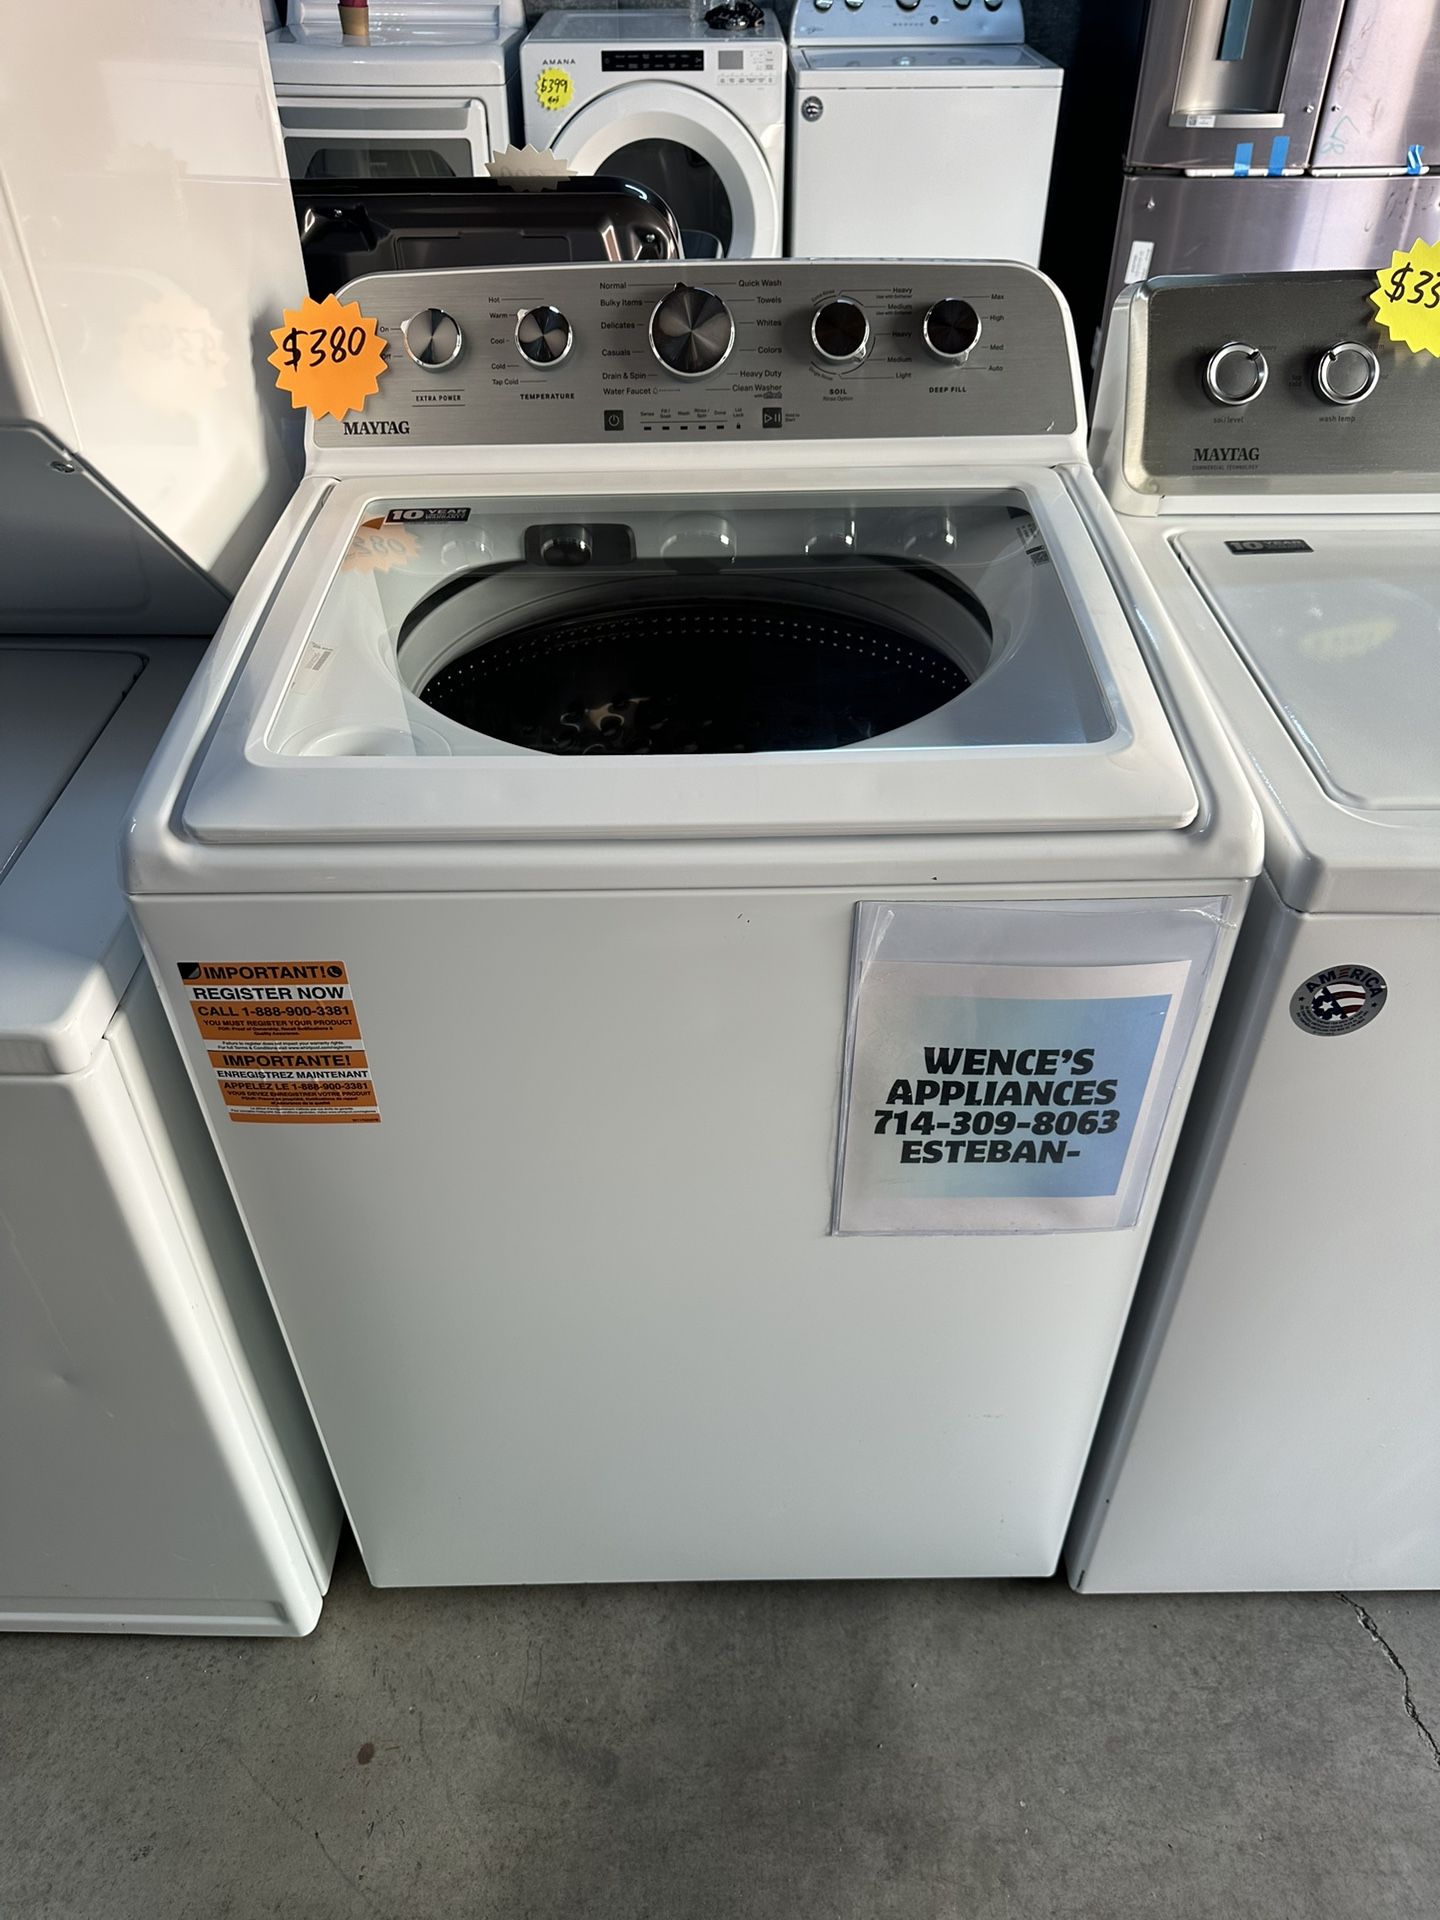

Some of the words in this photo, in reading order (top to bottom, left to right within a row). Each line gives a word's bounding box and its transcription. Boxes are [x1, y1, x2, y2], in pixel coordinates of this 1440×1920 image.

[738, 280, 760, 288] Quick
[757, 296, 782, 304] Towels
[990, 314, 1004, 322] High
[282, 325, 367, 373] $380
[758, 346, 782, 354] Colors
[602, 372, 622, 380] Drain
[630, 372, 646, 380] Spin
[740, 370, 763, 378] Heavy
[764, 370, 782, 378] Duty
[895, 372, 912, 380] Light
[626, 387, 651, 395] Faucet
[732, 384, 753, 392] Clean
[1226, 416, 1244, 424] level
[1338, 415, 1356, 424] temp
[343, 420, 410, 436] MAYTAG
[1193, 447, 1260, 462] MAYTAG
[392, 510, 425, 520] 10
[1230, 542, 1264, 551] 10
[204, 966, 326, 980] IMPORTANT!
[1305, 968, 1384, 998] AMERICA
[192, 986, 292, 1000] REGISTER
[297, 986, 344, 999] NOW
[198, 1007, 239, 1016] CALL
[242, 1006, 349, 1016] 1-888-900-3381
[223, 1055, 351, 1067] IMPORTANTE!
[923, 1046, 1095, 1076] WENCE'S
[217, 1070, 294, 1079] ENREGISTREZ
[296, 1070, 368, 1079] MAINTENANT
[291, 1082, 368, 1090] 1-888-900-3381
[885, 1078, 1118, 1106] APPLIANCES
[873, 1110, 1120, 1136] 714-309-8063
[900, 1139, 1081, 1164] ESTEBAN-
